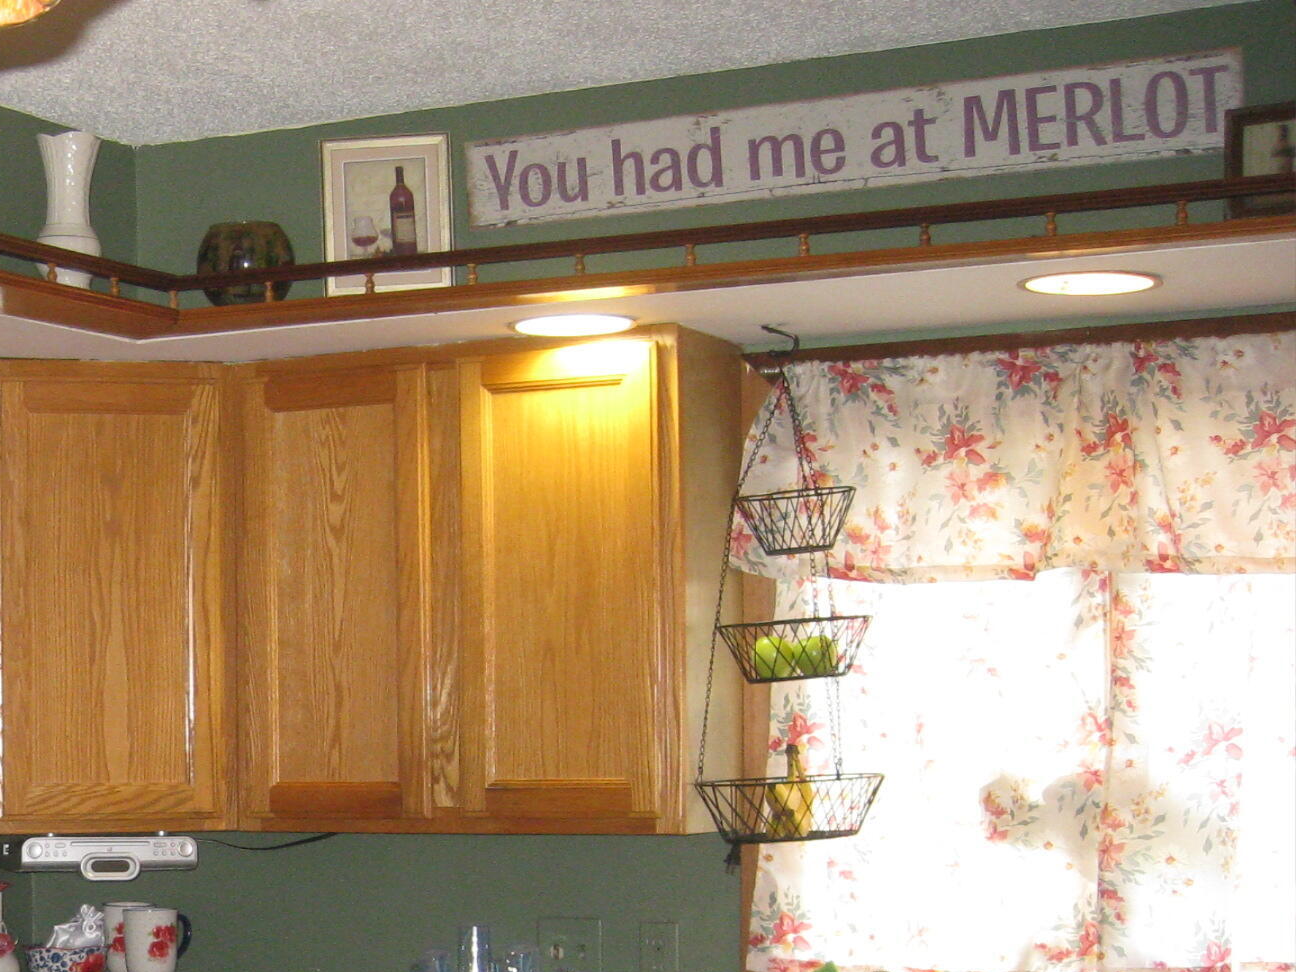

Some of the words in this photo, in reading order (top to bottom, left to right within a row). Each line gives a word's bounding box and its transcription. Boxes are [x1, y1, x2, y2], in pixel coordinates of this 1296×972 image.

[484, 150, 590, 211] You
[611, 126, 724, 196] had
[747, 128, 847, 181] me
[869, 108, 940, 169] at
[963, 64, 1229, 159] MERLOT
